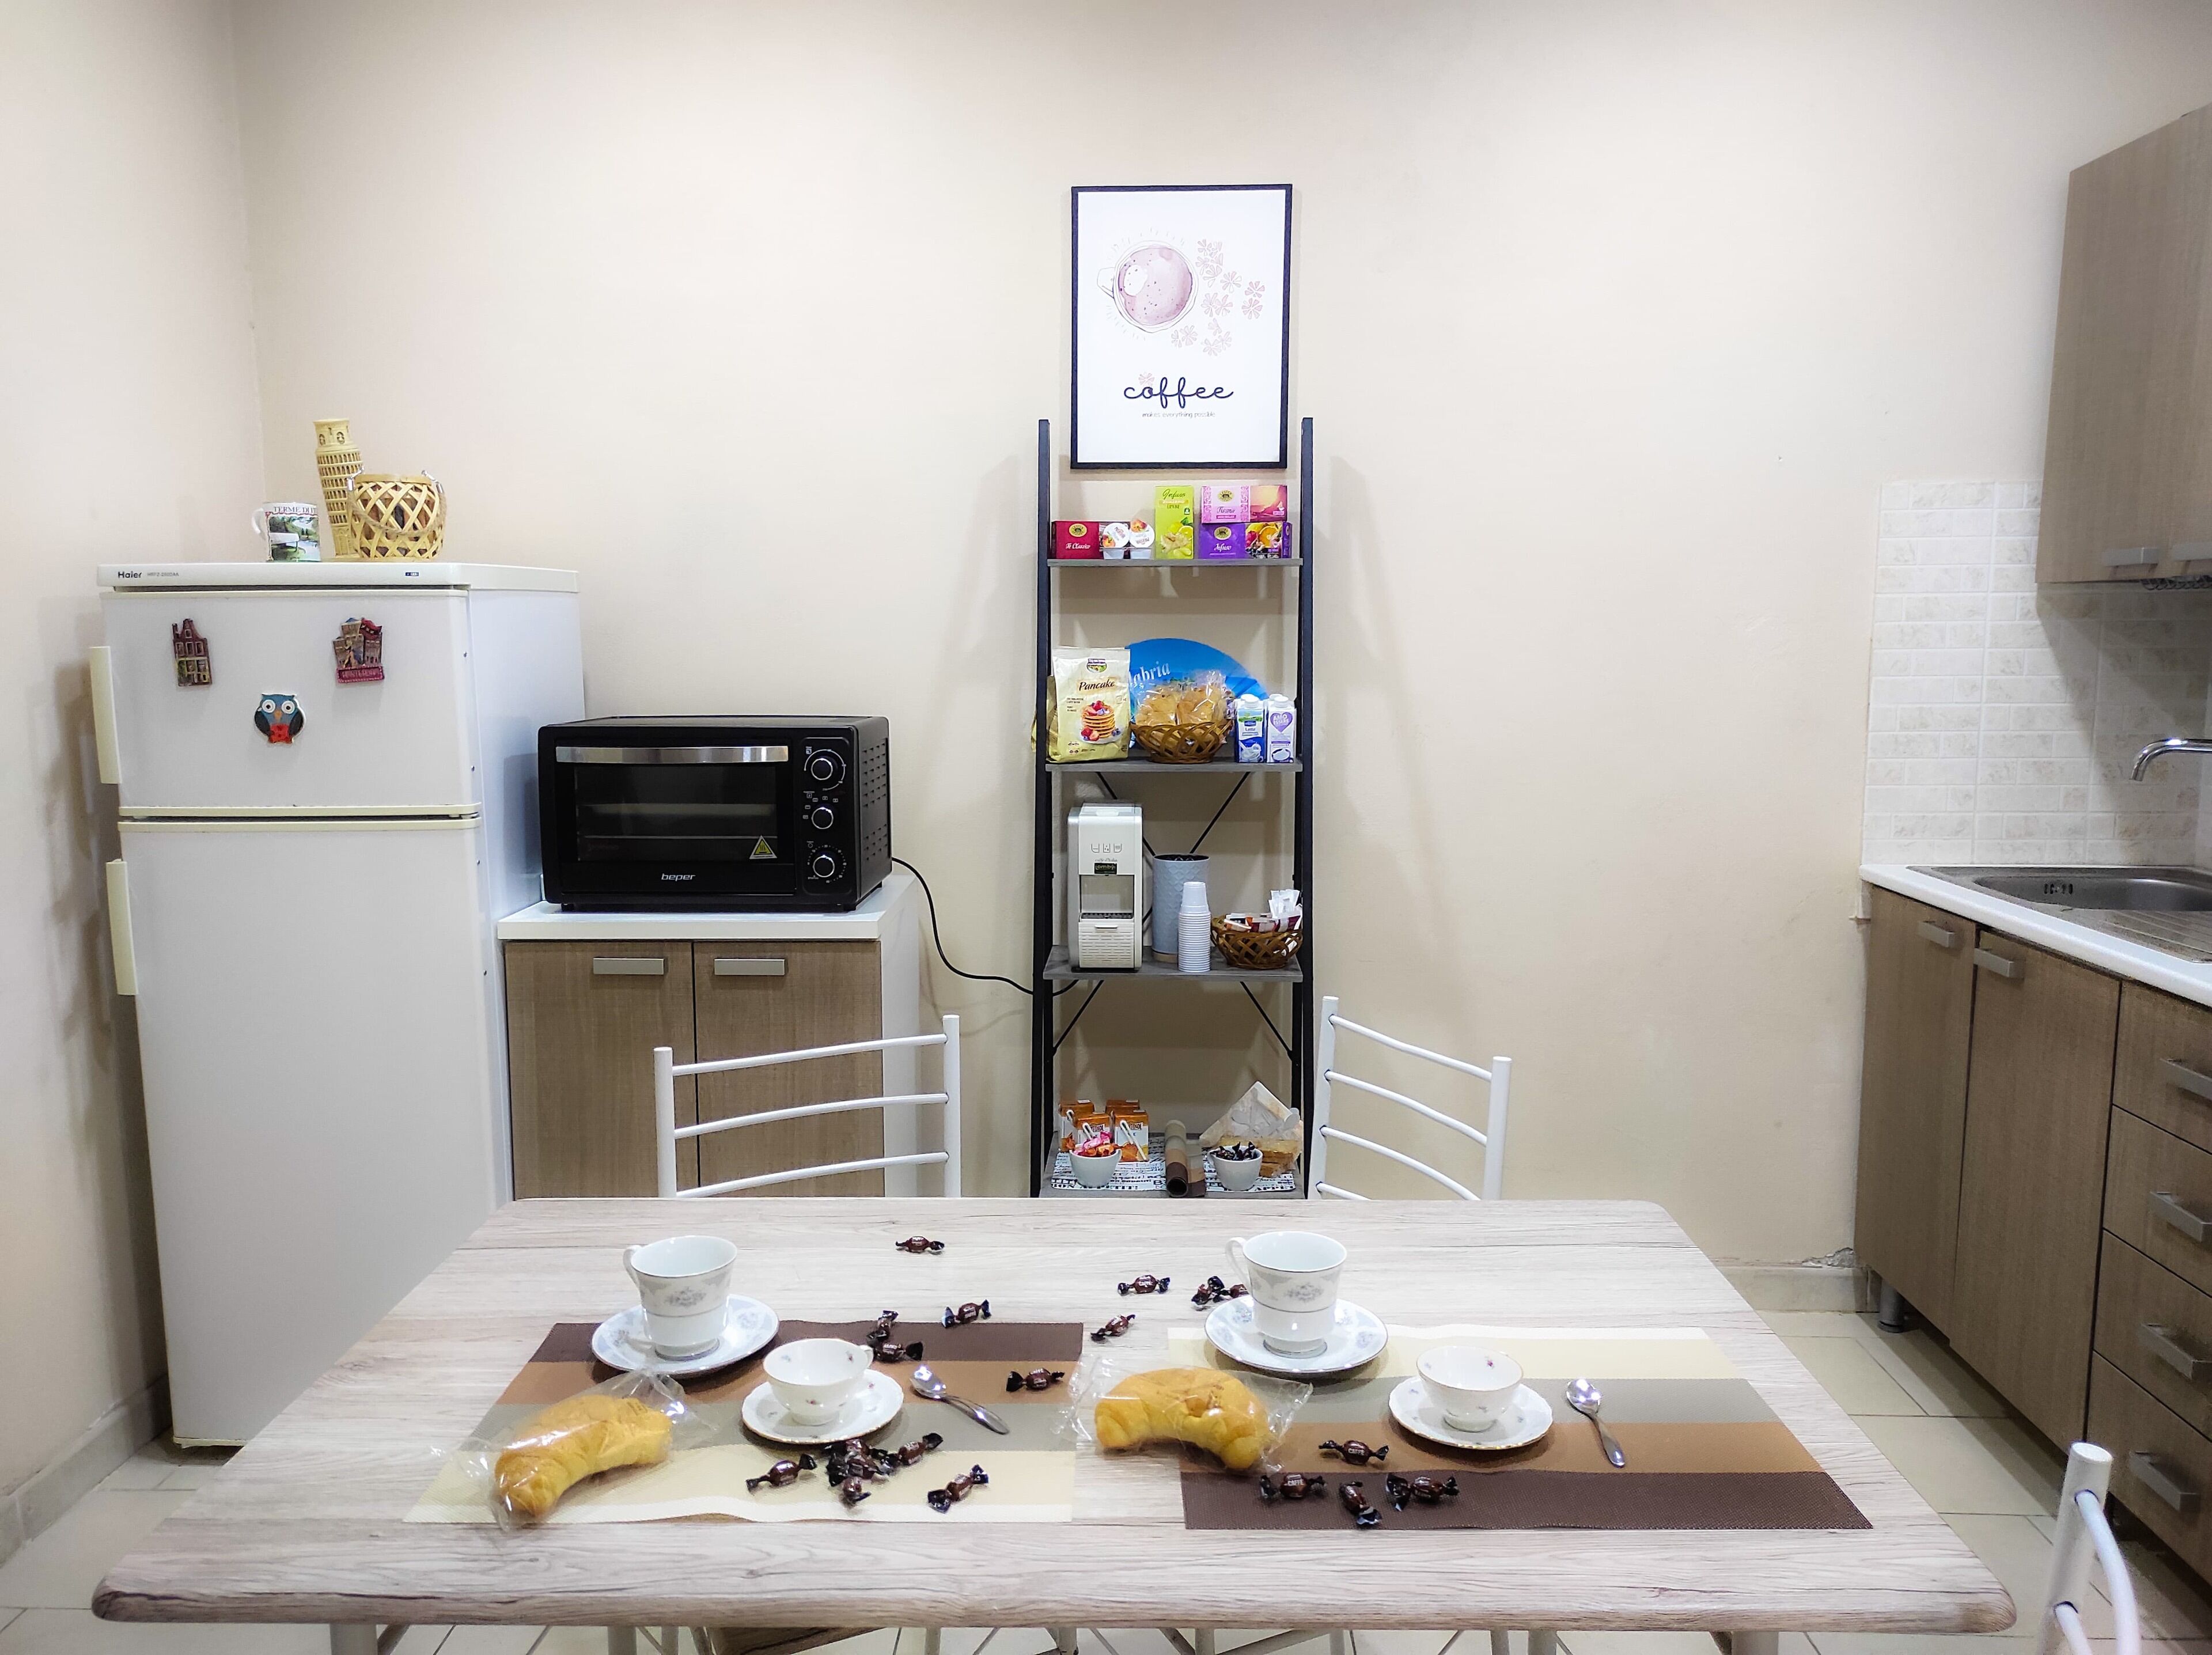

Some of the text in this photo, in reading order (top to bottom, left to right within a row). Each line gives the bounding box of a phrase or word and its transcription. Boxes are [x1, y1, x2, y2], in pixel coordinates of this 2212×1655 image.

[1123, 377, 1234, 408] coffee
[1079, 679, 1115, 691] Pancake
[661, 873, 696, 882] beper
